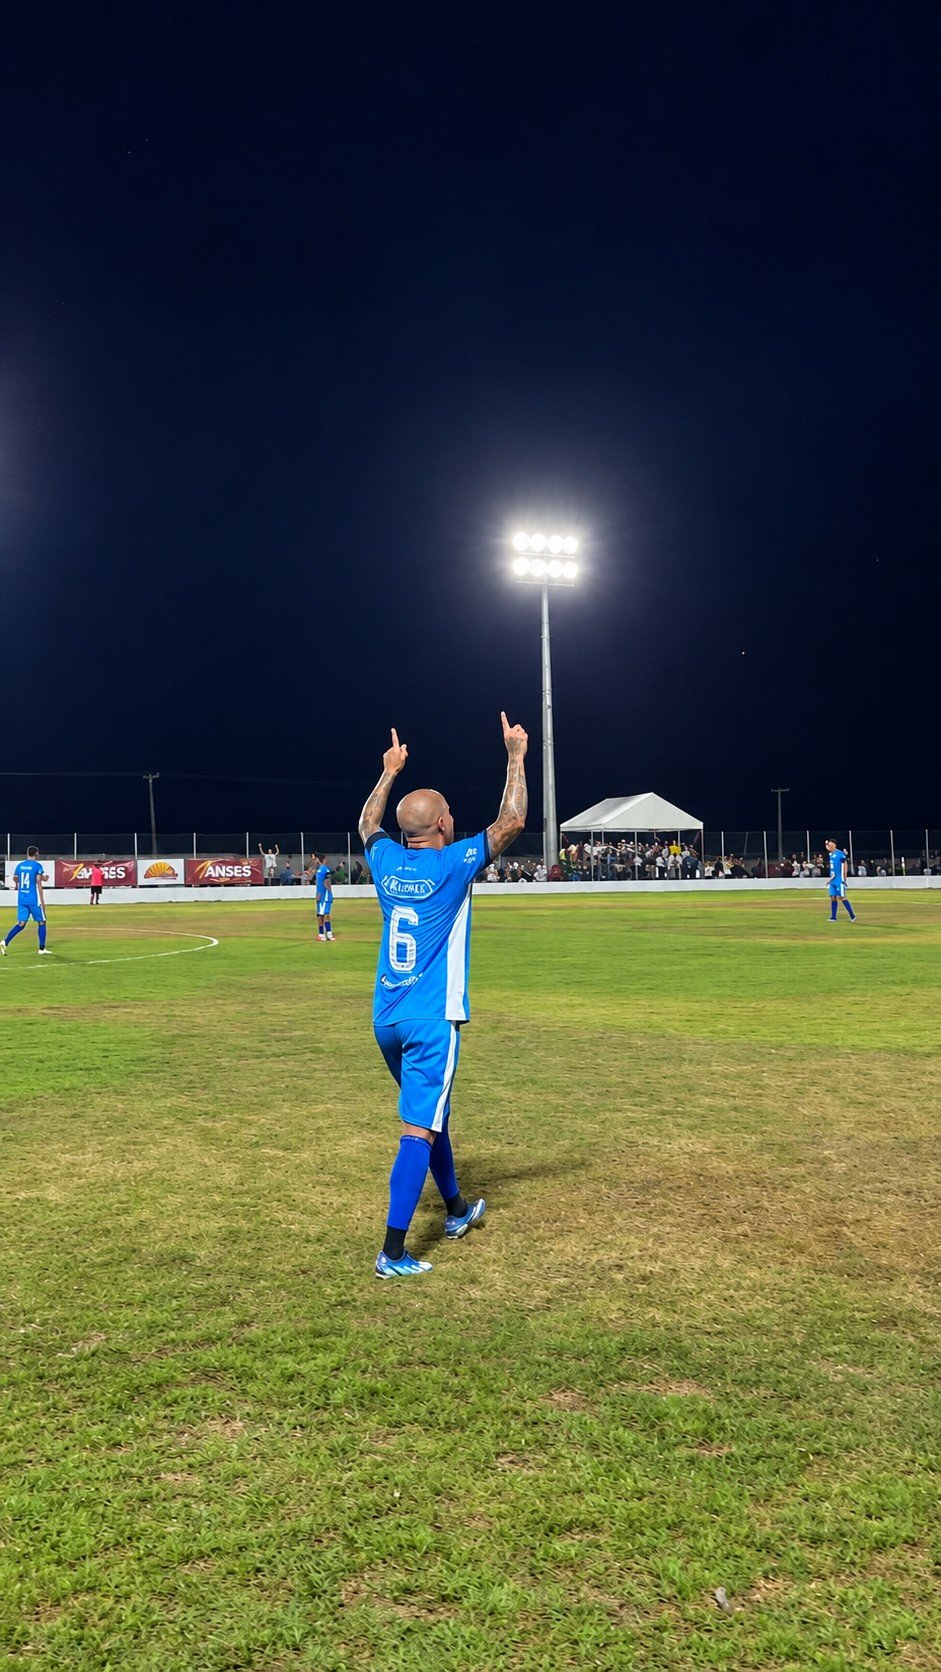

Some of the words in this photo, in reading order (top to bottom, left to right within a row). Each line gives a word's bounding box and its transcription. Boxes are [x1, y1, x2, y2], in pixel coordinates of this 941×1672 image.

[205, 866, 251, 877] ANSES
[21, 872, 30, 889] 14
[389, 905, 419, 974] 6
